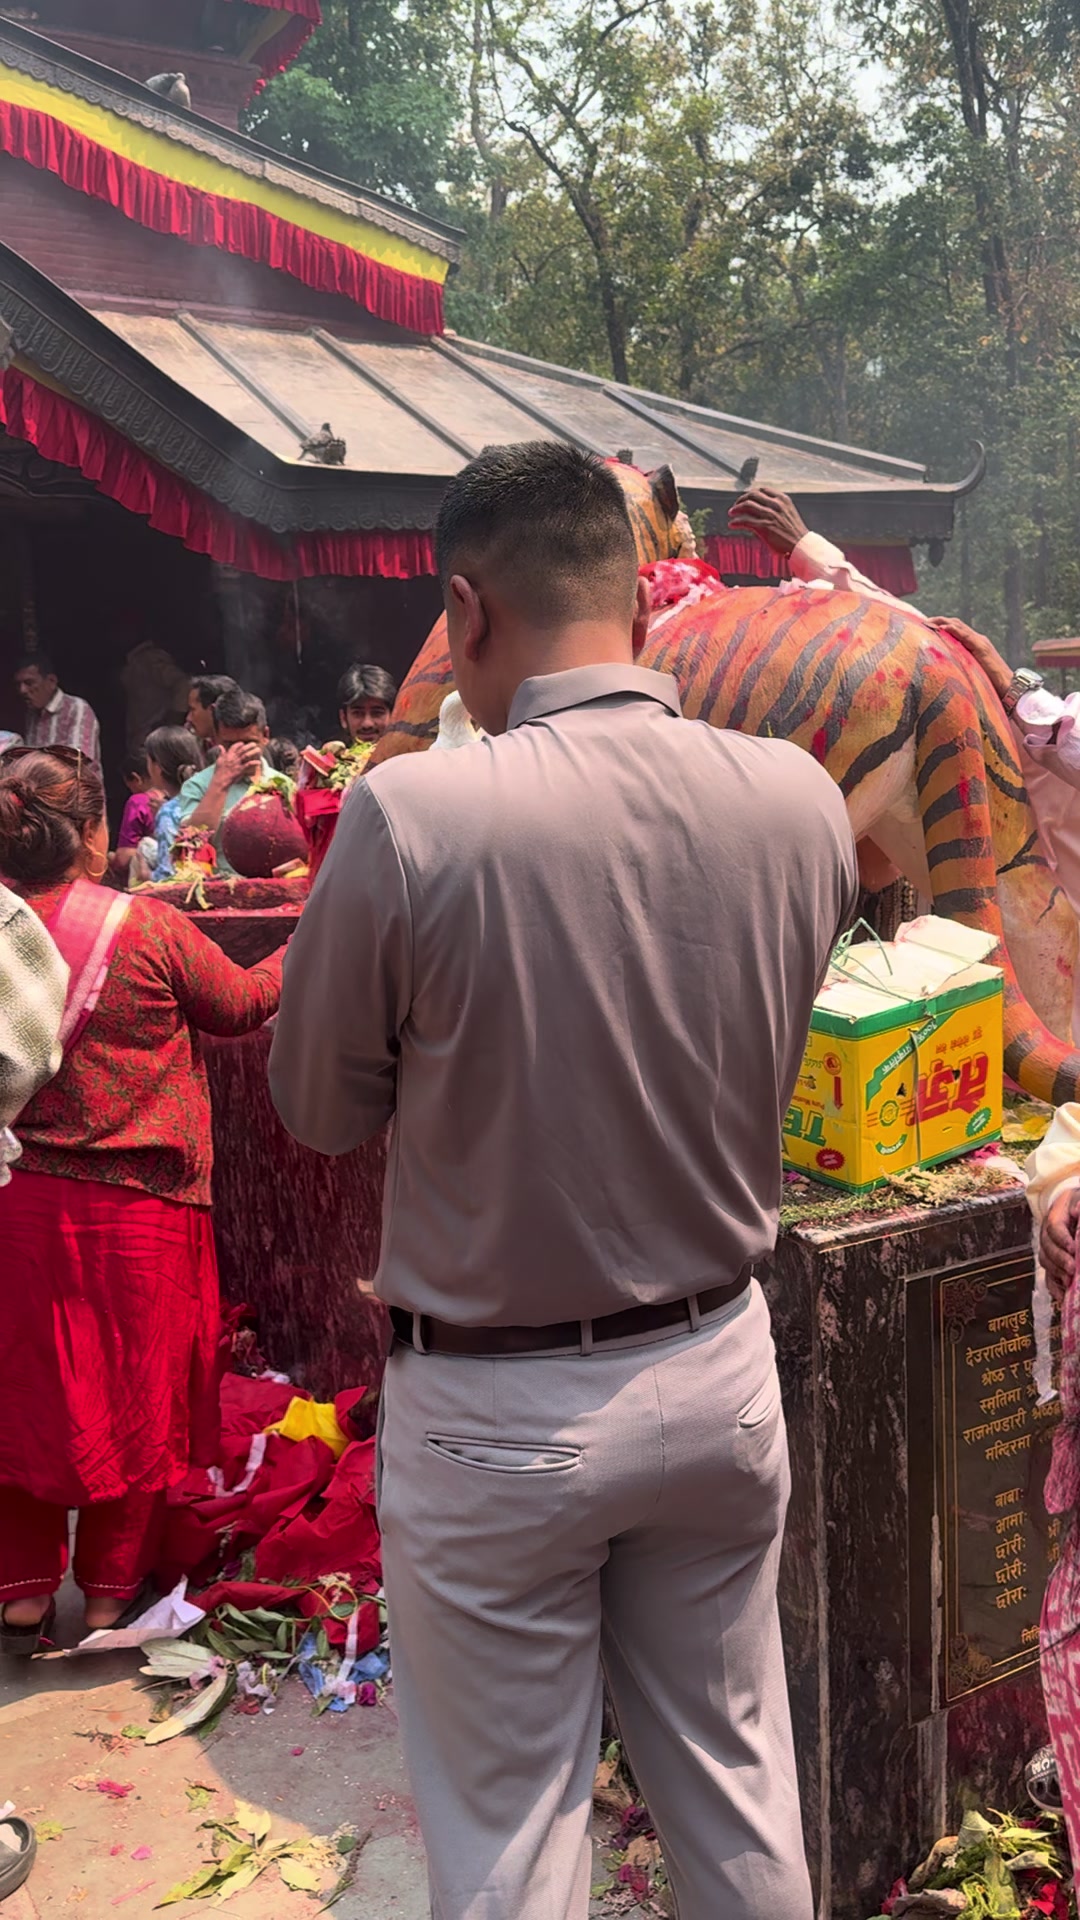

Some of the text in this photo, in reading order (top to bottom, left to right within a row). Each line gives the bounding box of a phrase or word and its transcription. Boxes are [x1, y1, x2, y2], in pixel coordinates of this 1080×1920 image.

[781, 1105, 827, 1147] TE
[988, 1309, 1029, 1332] बागलुङ
[966, 1333, 1032, 1367] देउरालीचोक
[979, 1388, 1022, 1415] स्मृतिमा
[963, 1407, 1027, 1445] राजभण्डारी
[985, 1439, 1031, 1461] मन्दिरमा
